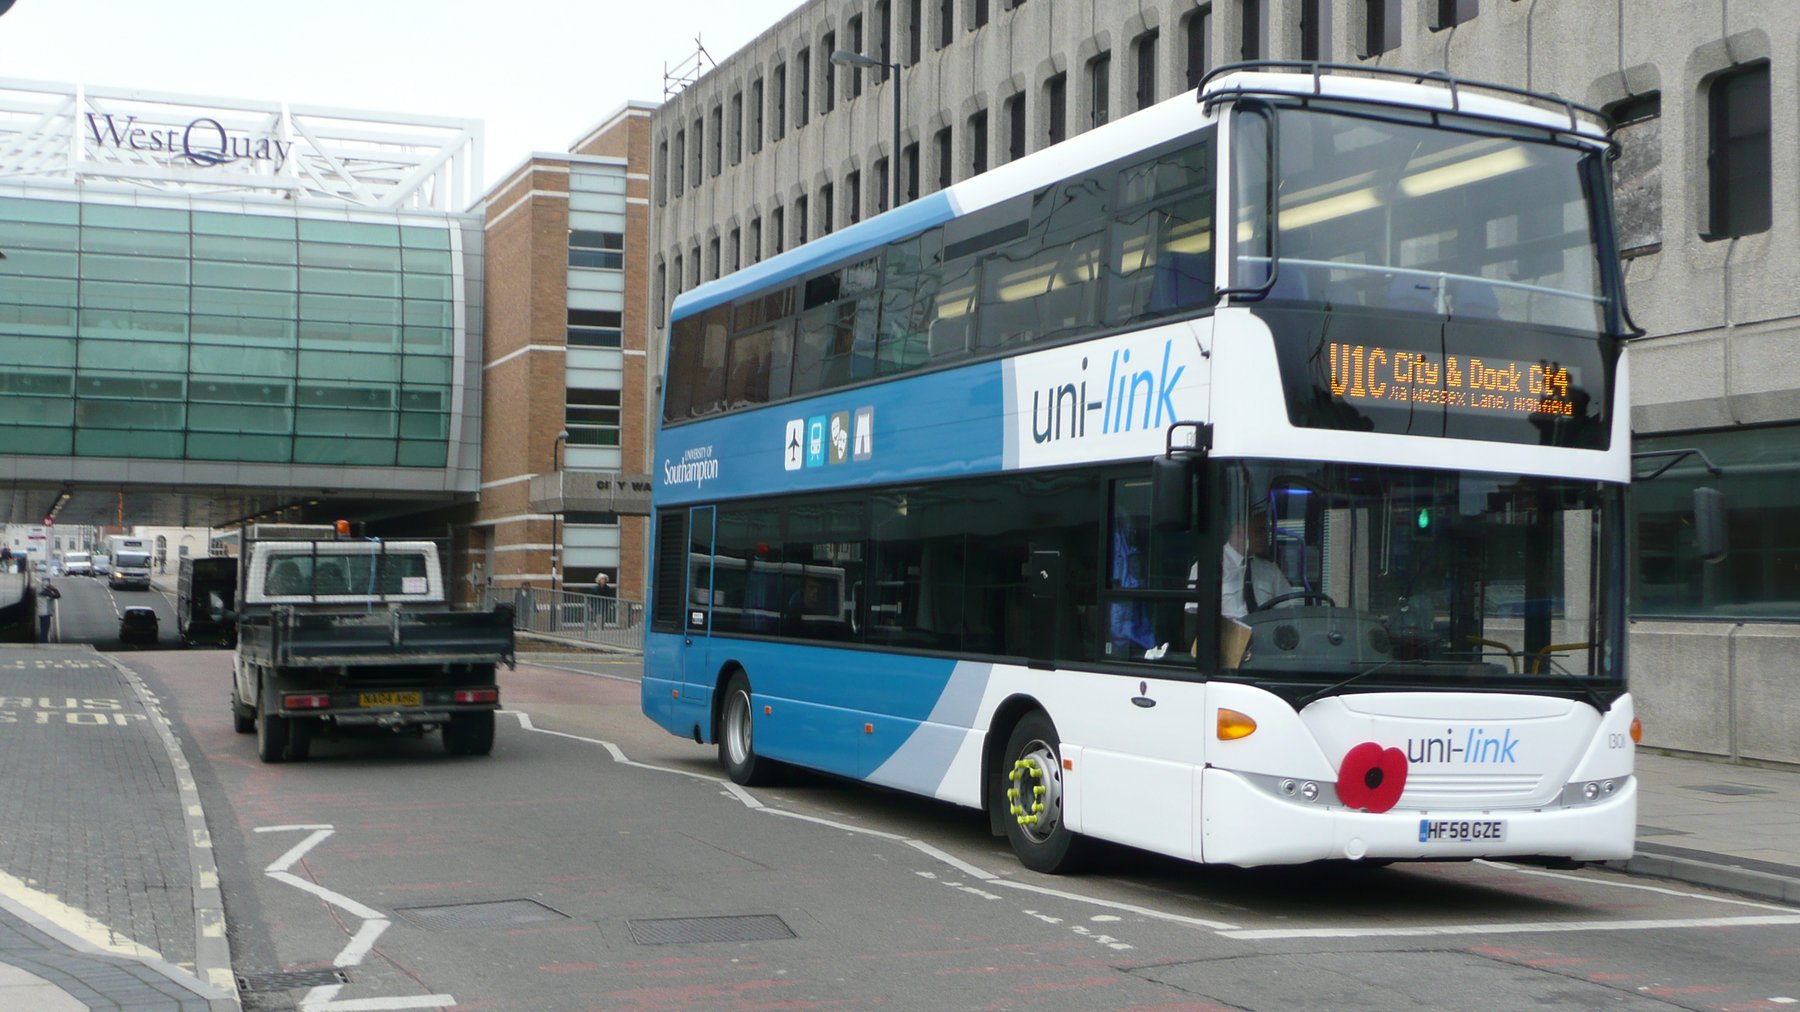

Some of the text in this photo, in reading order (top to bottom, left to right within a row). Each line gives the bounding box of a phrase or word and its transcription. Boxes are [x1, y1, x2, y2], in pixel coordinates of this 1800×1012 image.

[1330, 343, 1387, 399] U1C
[1394, 352, 1439, 385] City
[1446, 357, 1462, 387] &
[1469, 359, 1521, 392] Dock
[1033, 339, 1186, 444] uni-link
[685, 447, 706, 461] UNIVERSITY
[596, 480, 626, 491] CIY
[664, 457, 718, 489] Southampton
[1408, 728, 1520, 763] uni-link
[1428, 822, 1502, 839] HF58 GZE
